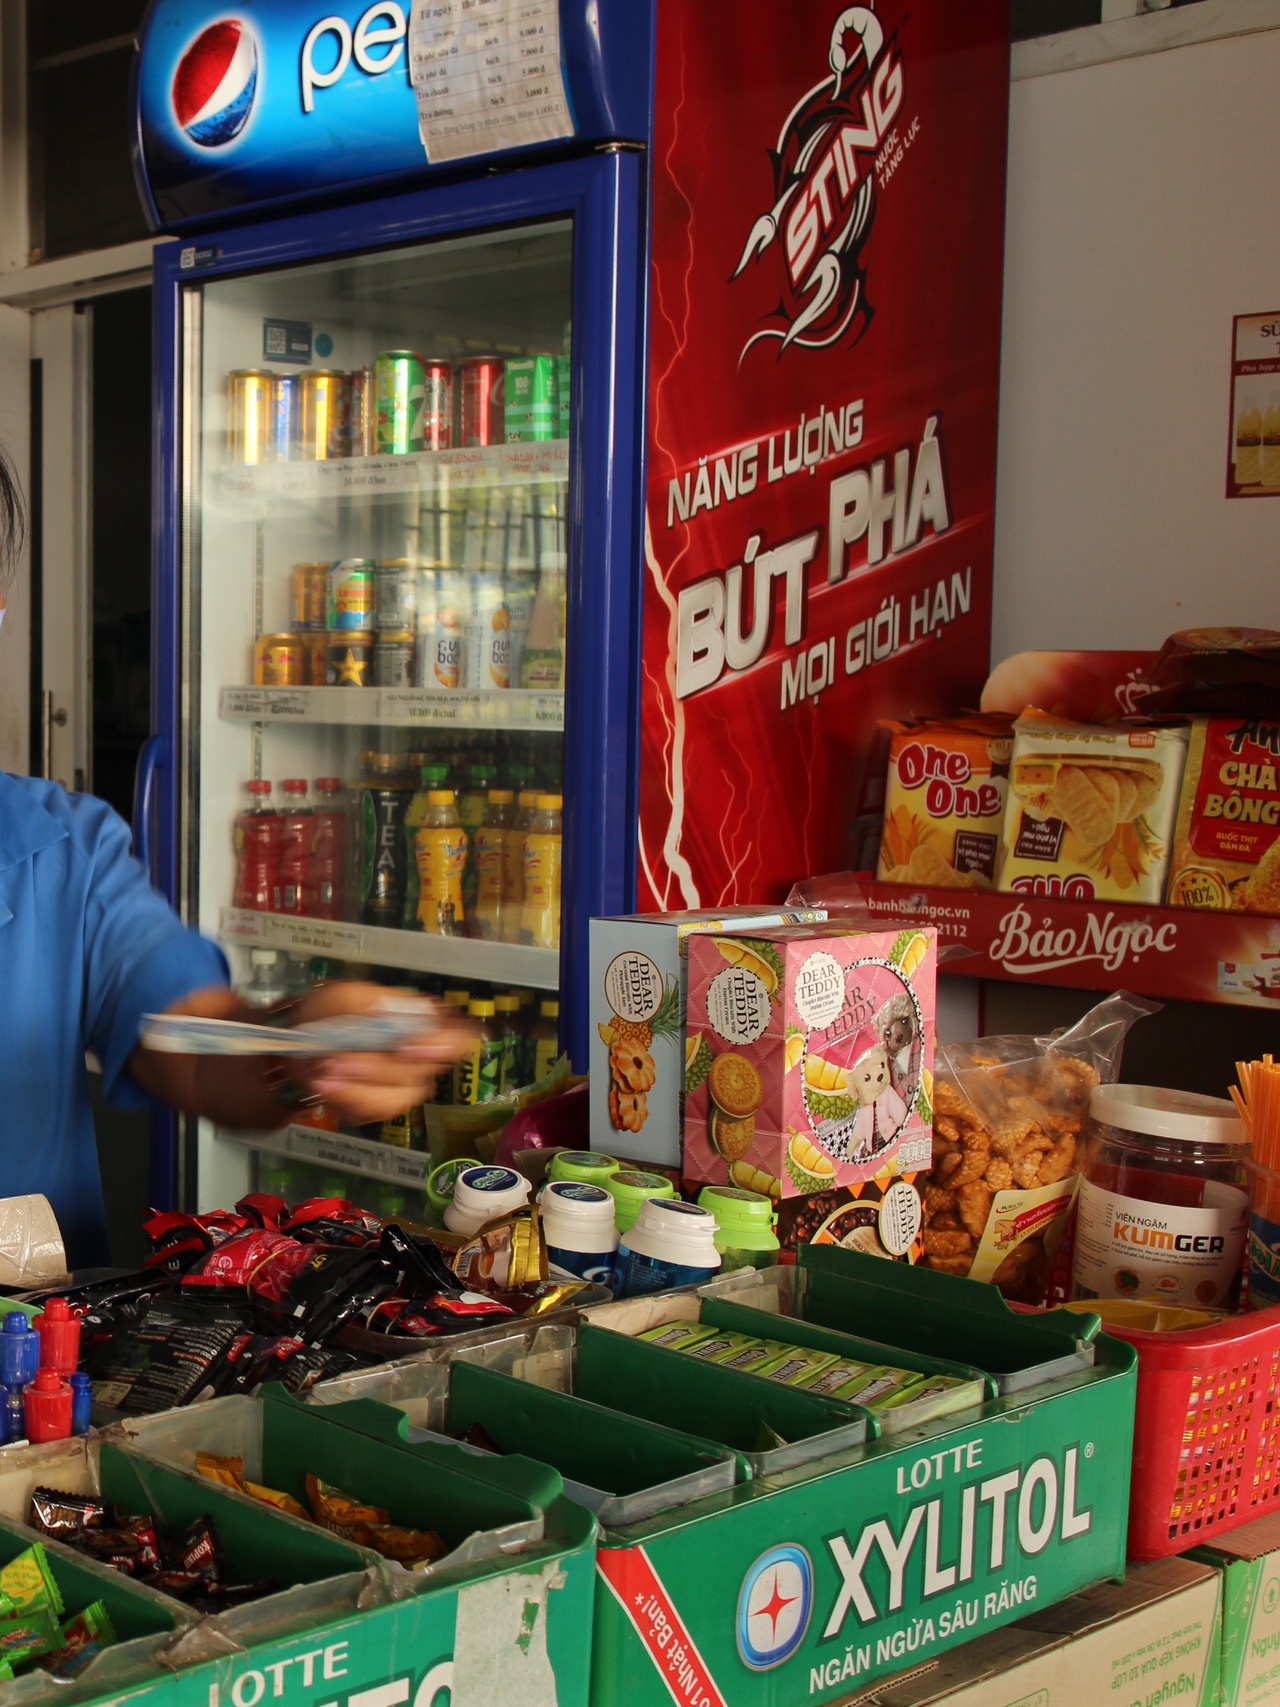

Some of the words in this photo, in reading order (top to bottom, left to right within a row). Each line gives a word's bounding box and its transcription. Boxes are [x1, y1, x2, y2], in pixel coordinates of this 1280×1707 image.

[299, 1, 415, 113] pe
[786, 51, 905, 283] STING
[874, 128, 899, 174] NƯỚC
[878, 147, 904, 189] TĂNG
[903, 116, 921, 149] LỰC
[667, 449, 758, 528] NĂNG
[767, 399, 864, 484] LƯỢNG
[676, 533, 819, 700] BỨT
[828, 416, 950, 584] PHÁ
[780, 637, 835, 712] MỌI
[845, 596, 903, 676] GIỚI
[909, 566, 972, 644] HẠN
[897, 741, 971, 788] One
[1219, 757, 1278, 791] CHÀ
[925, 776, 1001, 817] One
[1202, 790, 1280, 826] BÔNG
[376, 801, 399, 869] TEA
[1216, 831, 1239, 843] RUỐC
[1240, 835, 1258, 846] THỊT
[1182, 885, 1214, 908] 100%
[628, 956, 644, 1018] TEDDY
[639, 961, 654, 1012] DEAR
[798, 975, 841, 999] TEDDY
[802, 963, 836, 985] DEAR
[733, 972, 749, 1039] TEDDY
[745, 978, 760, 1031] DEAR
[842, 986, 865, 1012] AR
[897, 1185, 909, 1245] TEDDY
[905, 1190, 915, 1238] DEAR
[1115, 1211, 1136, 1224] VIÊN
[1136, 1217, 1168, 1231] NGẬM
[896, 1438, 983, 1494] LOTTE
[184, 1537, 210, 1569] KOPIKO
[823, 1446, 1091, 1639] XYLITOL
[809, 1645, 870, 1694] NGĂN
[875, 1613, 936, 1666] NGỪA
[937, 1597, 980, 1644] SÂU
[983, 1575, 1038, 1619] RĂNG
[1175, 1635, 1202, 1660] KHÔNG
[1251, 1630, 1280, 1659] Nguy
[208, 1641, 349, 1707] LOTTE
[666, 1638, 699, 1696] Nhật
[1111, 1671, 1127, 1690] LỚP
[1129, 1667, 1139, 1682] 10
[1141, 1656, 1157, 1678] QUÁ
[1159, 1649, 1174, 1669] XẾP
